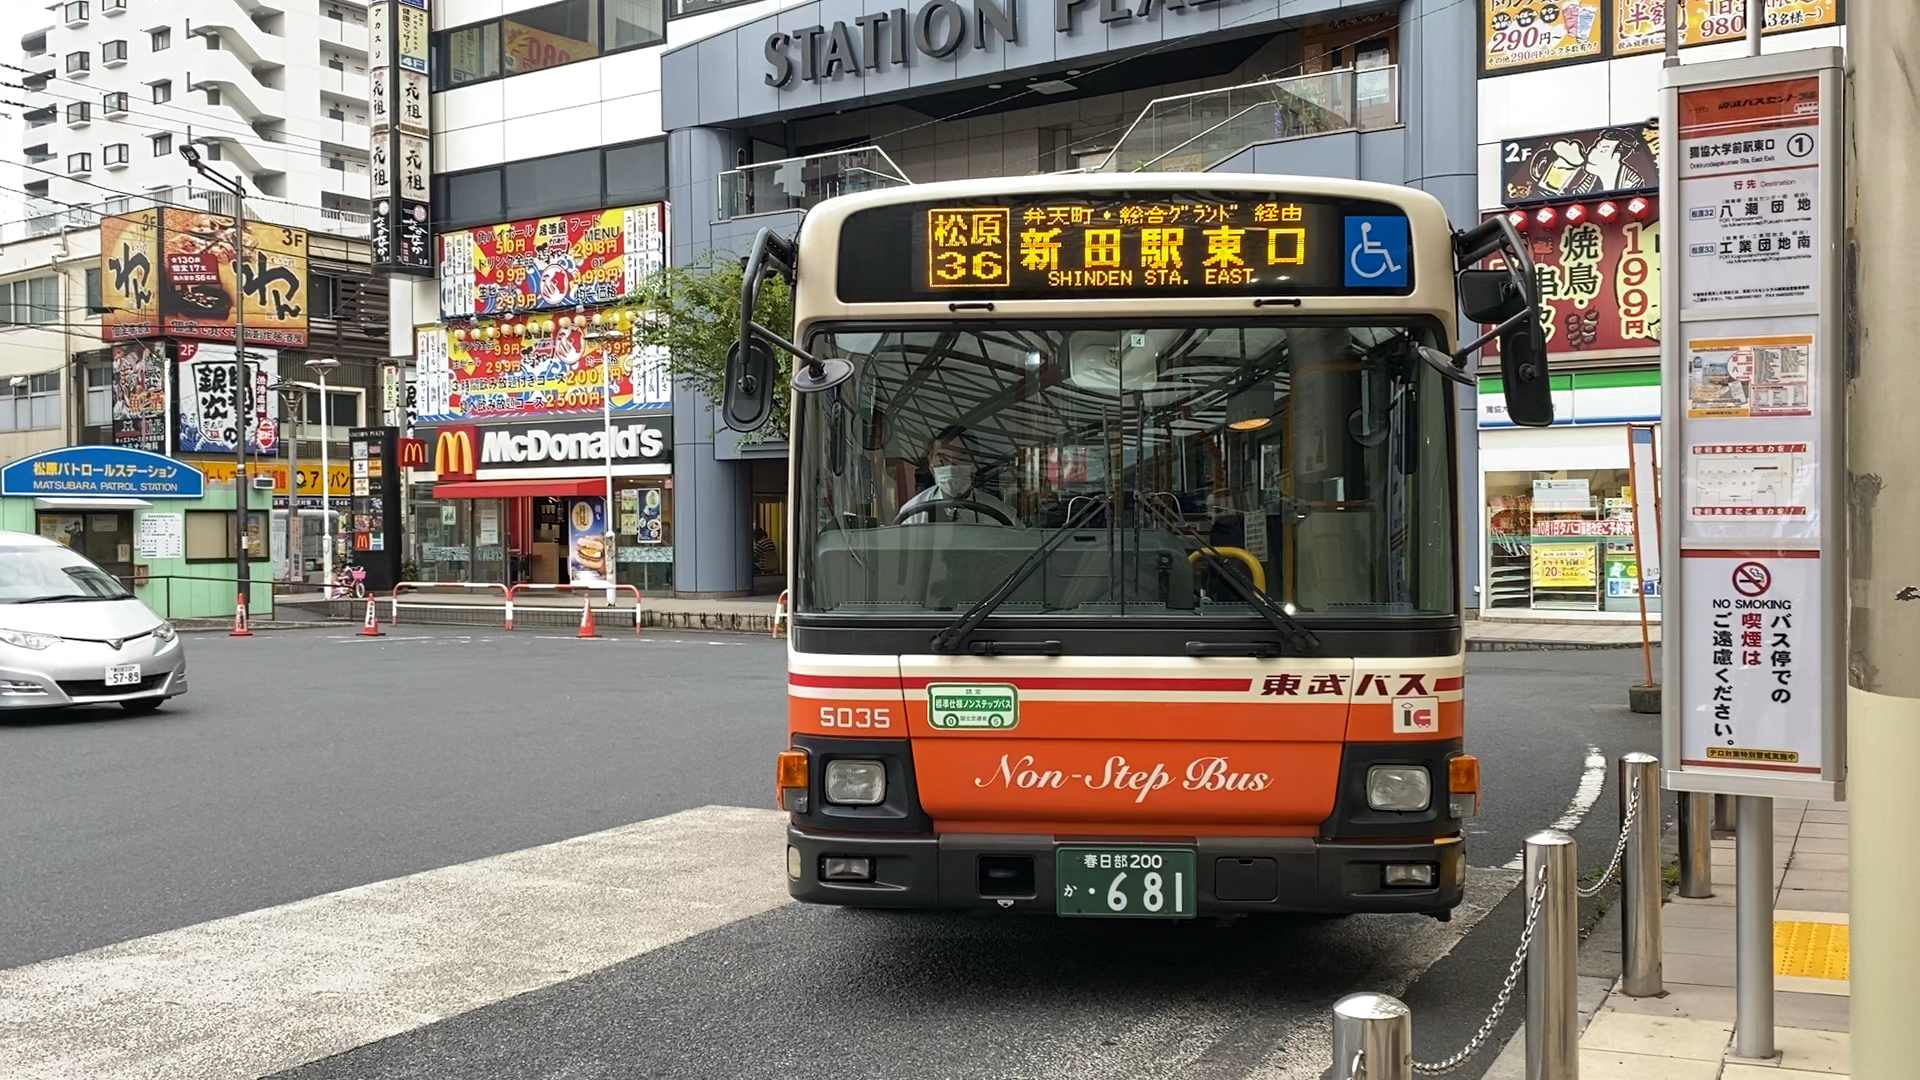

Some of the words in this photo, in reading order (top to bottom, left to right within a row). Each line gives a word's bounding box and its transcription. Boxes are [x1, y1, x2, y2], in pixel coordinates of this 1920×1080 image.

[764, 0, 1018, 88] STATION
[402, 55, 424, 70] 4F
[373, 81, 386, 115] 元祖
[405, 83, 422, 118] 元祖
[1504, 142, 1532, 163] 2F
[1690, 139, 1775, 159] 獨協大学前駅東口
[373, 147, 389, 185] 元祖
[406, 150, 425, 191] 元祖
[1734, 180, 1756, 190] 行先
[1761, 180, 1796, 188] Destination
[1255, 203, 1302, 222] 経由
[1720, 198, 1811, 218] 八潮団地
[142, 214, 156, 232] 3F
[934, 214, 1001, 246] 松原
[282, 229, 303, 247] 3F
[584, 226, 621, 242] MENU
[495, 239, 526, 254] 50円
[573, 240, 617, 257] 298円
[1020, 225, 1305, 271] 新田駅東口
[1720, 235, 1811, 254] 工業団地南
[495, 267, 526, 283] 99円
[937, 251, 1001, 280] 36
[1048, 270, 1132, 286] SHINDEN
[1145, 269, 1189, 285] STA.
[1205, 269, 1254, 285] EAST
[495, 293, 536, 310] 299円
[180, 345, 195, 356] 2F
[486, 361, 520, 374] 299円
[198, 363, 228, 420] 銀次
[481, 424, 664, 463] McDonald's
[33, 461, 177, 479] 松原パトロールステーション
[33, 480, 97, 490] MATSUBARA
[100, 482, 137, 491] PATROL
[140, 483, 177, 492] STATION
[1713, 599, 1731, 609] NO
[1735, 599, 1791, 610] SMOKING
[1741, 613, 1762, 666] 喫煙は
[1770, 614, 1791, 704] バス停での
[113, 672, 139, 683] 57-89
[1260, 674, 1428, 696] 東武バス
[1713, 612, 1734, 746] ご遠慮ください。
[936, 699, 1012, 709] 標準仕様ノンステップバス
[820, 707, 890, 728] 5035
[975, 754, 1176, 803] Non-Step
[1182, 756, 1275, 791] Bus
[1063, 884, 1077, 897] か
